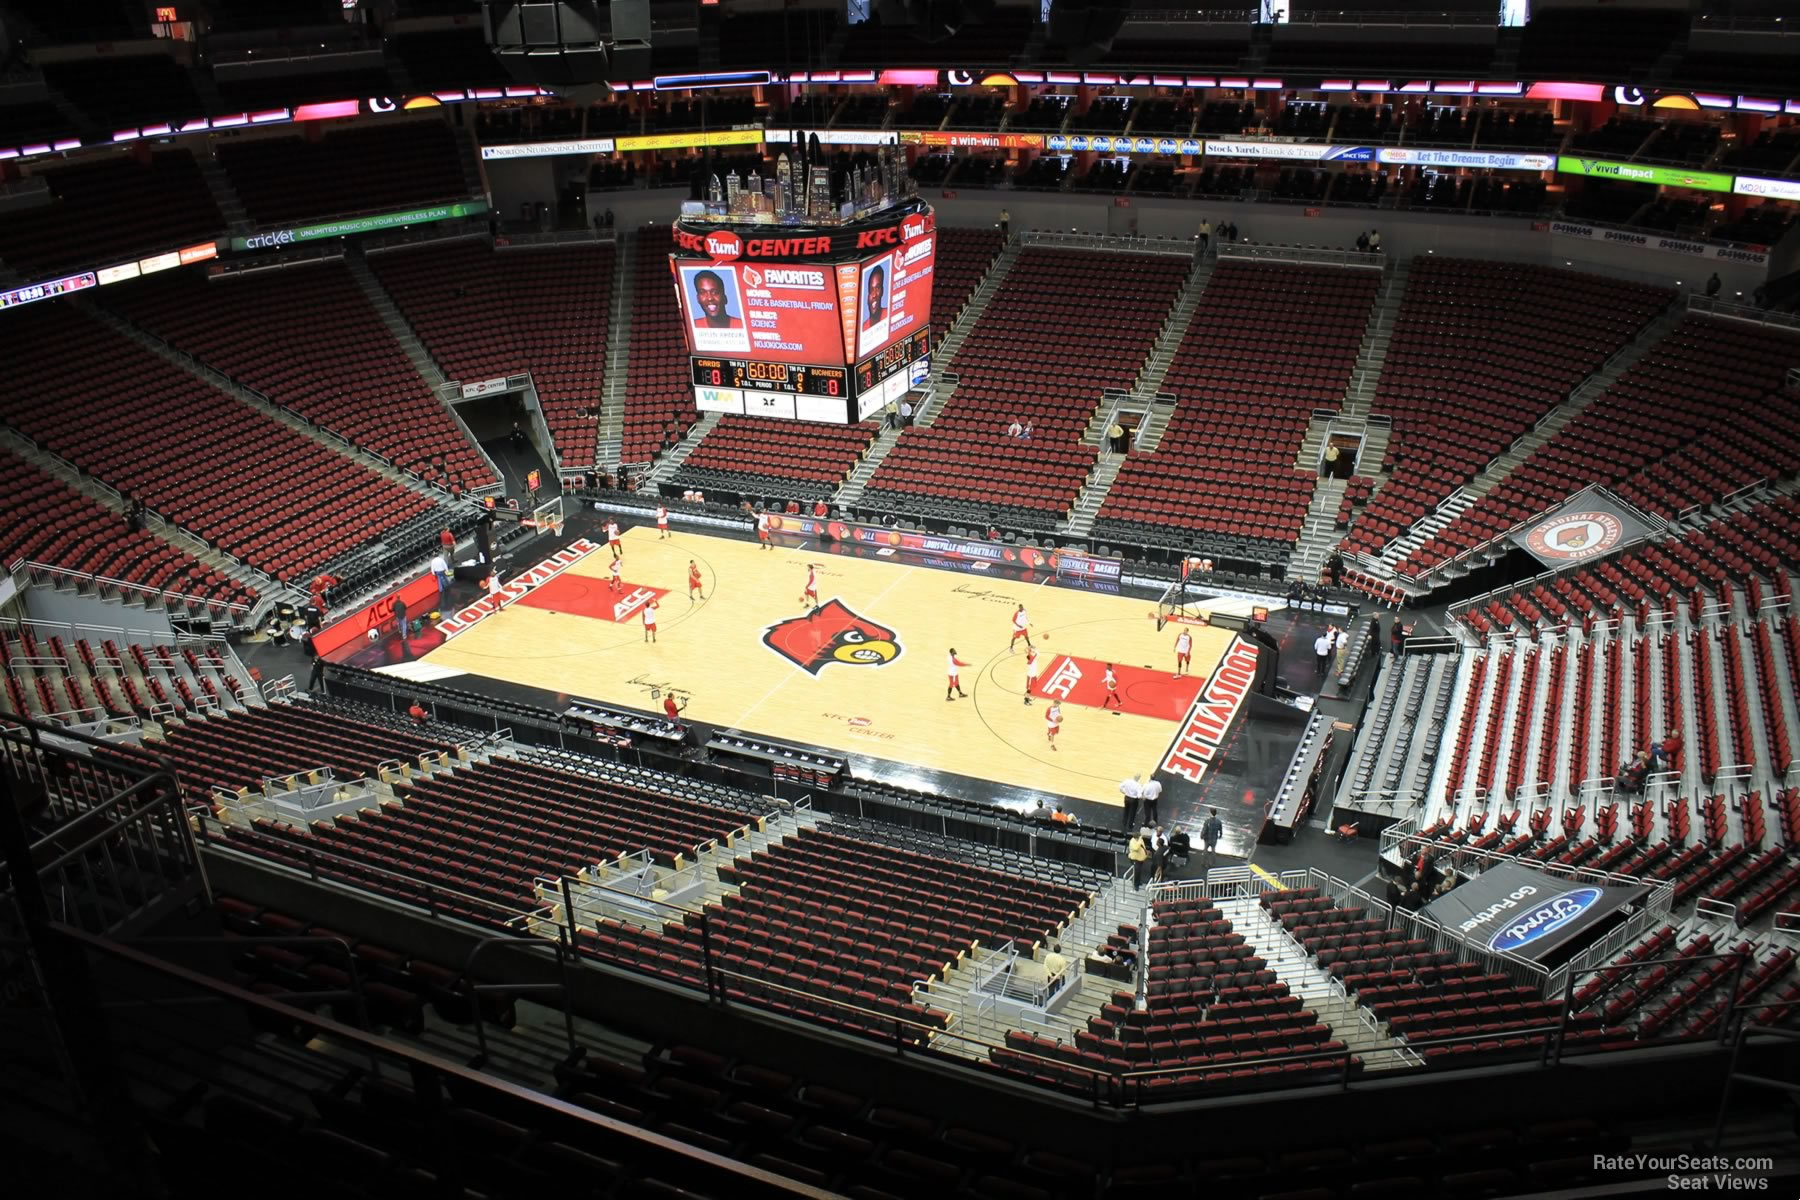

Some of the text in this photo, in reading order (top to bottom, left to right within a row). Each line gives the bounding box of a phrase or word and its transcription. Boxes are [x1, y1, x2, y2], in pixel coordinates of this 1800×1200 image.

[951, 136, 957, 145] a
[959, 135, 1000, 146] win-win
[1208, 144, 1322, 157] Stock Yards Bank & Trust
[1418, 152, 1432, 161] Let
[1434, 152, 1450, 162] The
[1452, 154, 1486, 164] Dreams
[1488, 154, 1514, 166] Begin
[1740, 183, 1766, 194] MD2U
[300, 226, 338, 238] UNLIMITED
[340, 223, 360, 231] MUSIC
[374, 218, 393, 226] YOUR
[394, 214, 427, 222] WIRELESS
[428, 210, 447, 218] PLAN
[246, 230, 296, 249] cricket
[857, 226, 898, 248] KFC
[904, 220, 924, 240] Yum!
[680, 232, 832, 256] KFC Yum! CENTER
[764, 269, 824, 286] FAVORITES
[748, 298, 764, 306] LOVE
[770, 300, 810, 310] BASKETBALL,
[810, 302, 834, 310] FRIDAY
[751, 320, 776, 328] SCIENCE
[698, 360, 720, 368] CARDS
[738, 368, 743, 377] 0
[748, 362, 786, 380] 60:00
[756, 381, 772, 389] PERIOD
[704, 390, 733, 402] WM
[1537, 514, 1618, 545] CARDINAL ATHLETIC
[922, 540, 1002, 558] LOUISVILLE BASKETBALL
[614, 587, 656, 621] ACC
[1042, 657, 1082, 699] ACC
[1161, 634, 1260, 784] LOUISVILLE
[849, 728, 896, 740] CENTER
[1458, 885, 1537, 934] Go Further
[1506, 898, 1583, 943] Ford
